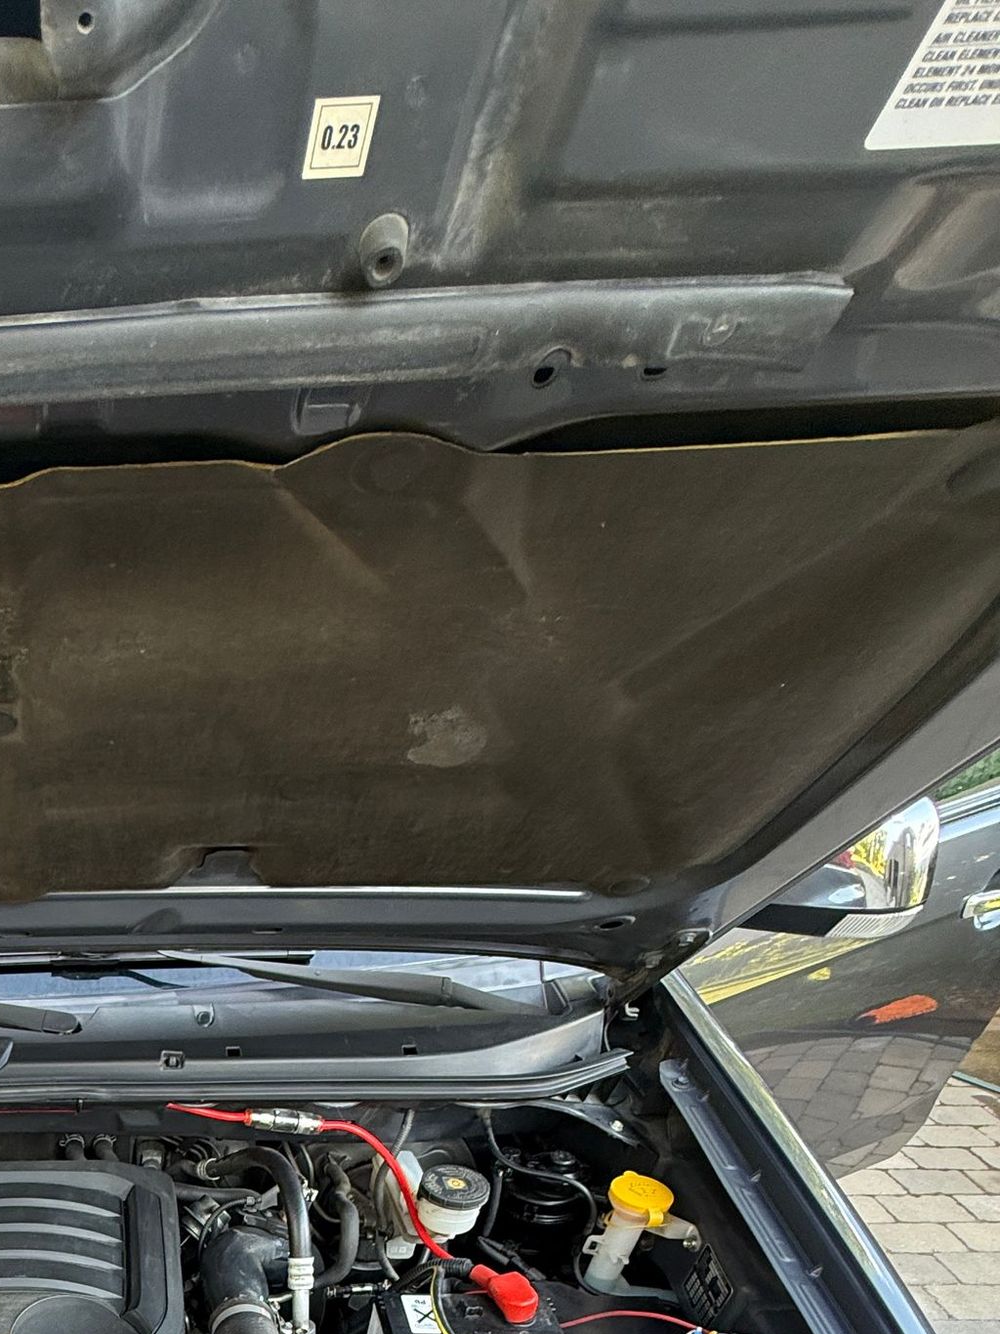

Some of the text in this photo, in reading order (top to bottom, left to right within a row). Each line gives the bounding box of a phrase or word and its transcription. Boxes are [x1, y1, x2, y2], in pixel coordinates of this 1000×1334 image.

[912, 65, 962, 78] ELEMENT
[894, 97, 930, 109] CLEAN
[944, 94, 992, 107] REPLACE
[321, 123, 360, 150] 0.23
